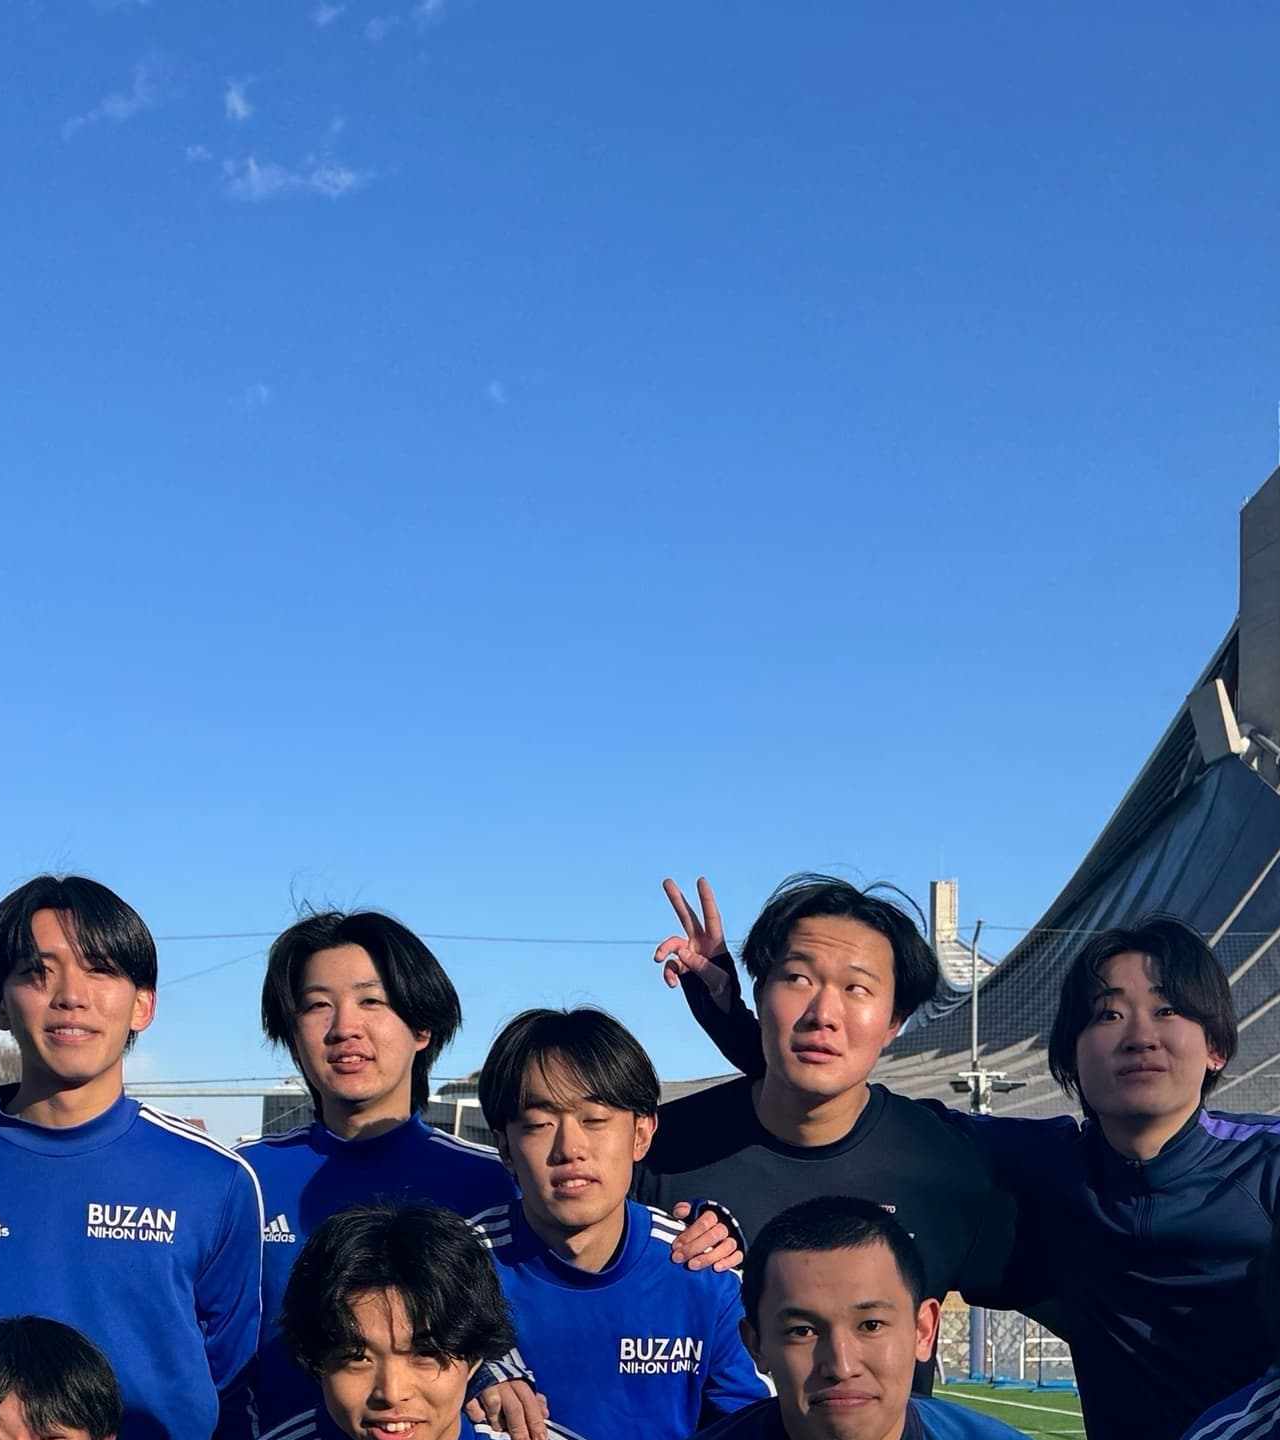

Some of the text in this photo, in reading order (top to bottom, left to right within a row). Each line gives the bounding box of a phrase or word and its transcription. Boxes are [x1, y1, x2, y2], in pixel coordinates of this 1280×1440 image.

[88, 1203, 176, 1231] BUZAN
[87, 1225, 174, 1244] NIHON UNIV.
[264, 1231, 296, 1243] didas
[620, 1337, 703, 1361] BUZAN
[619, 1361, 667, 1374] NIHON
